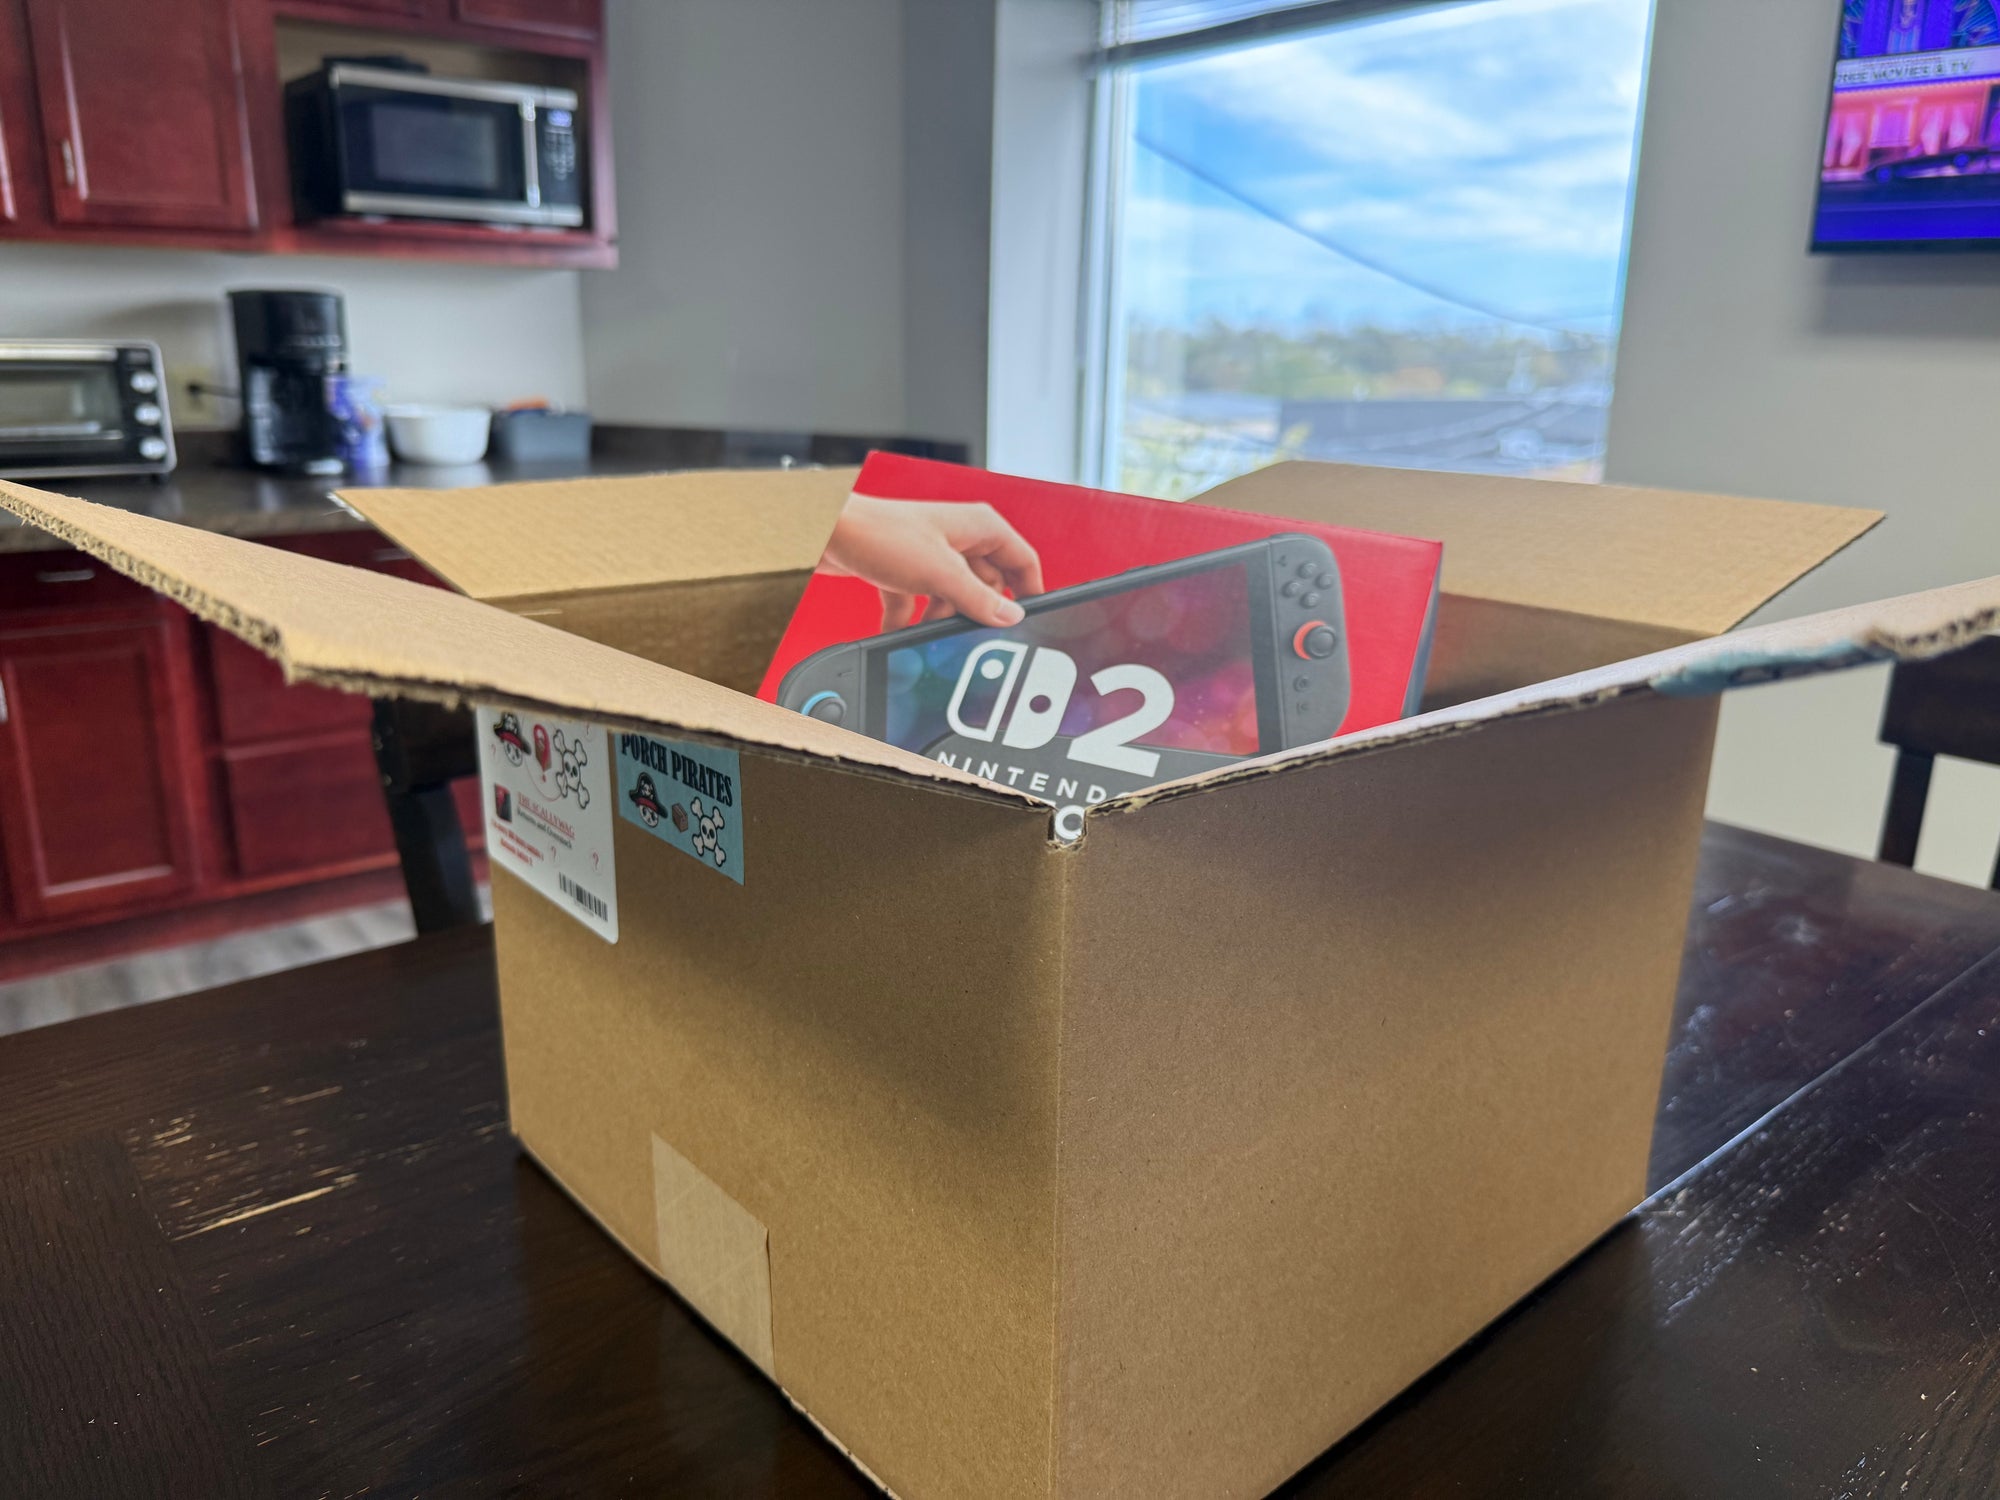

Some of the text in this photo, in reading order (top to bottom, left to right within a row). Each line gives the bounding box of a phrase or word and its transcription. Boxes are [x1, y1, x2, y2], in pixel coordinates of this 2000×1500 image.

[1872, 65, 1930, 82] MOVIES
[1951, 60, 1974, 75] TV
[1066, 663, 1175, 778] 2
[621, 733, 733, 808] PORCH PIRATES
[936, 751, 1130, 805] NINTEND
